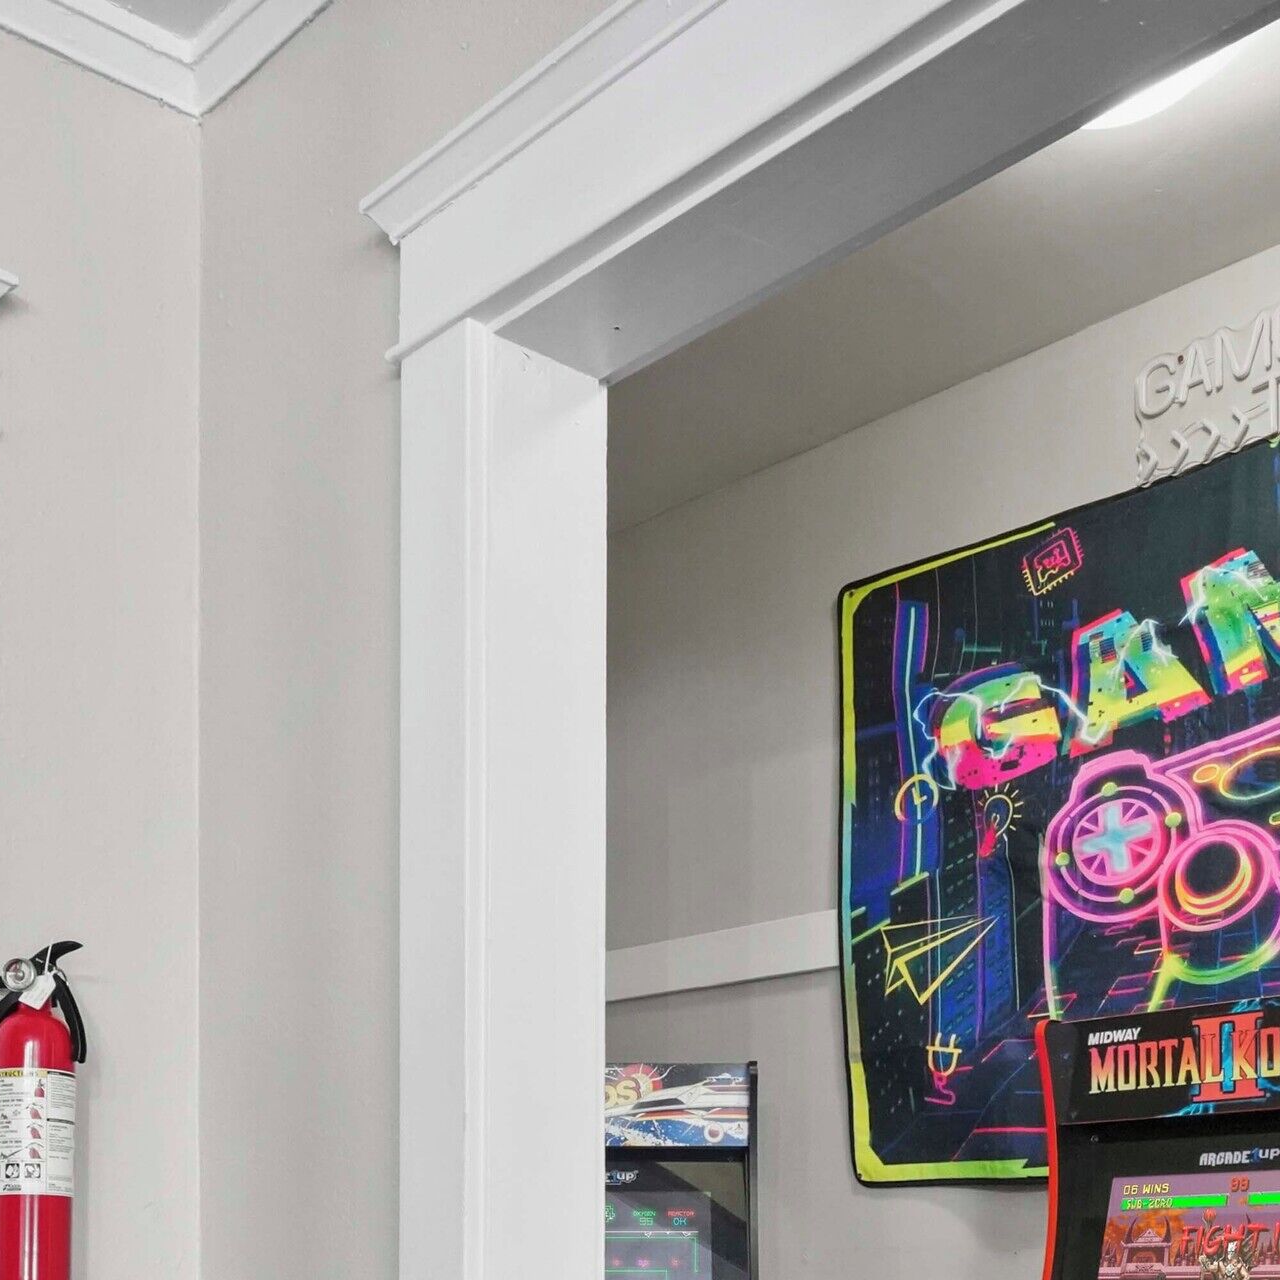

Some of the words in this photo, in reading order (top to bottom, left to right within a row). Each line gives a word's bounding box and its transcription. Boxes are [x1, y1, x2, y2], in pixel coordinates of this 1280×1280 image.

[1088, 1027, 1141, 1046] MIDWAY
[1089, 1033, 1223, 1094] MORTAL
[1124, 1185, 1138, 1195] 06
[1143, 1183, 1169, 1194] WINS
